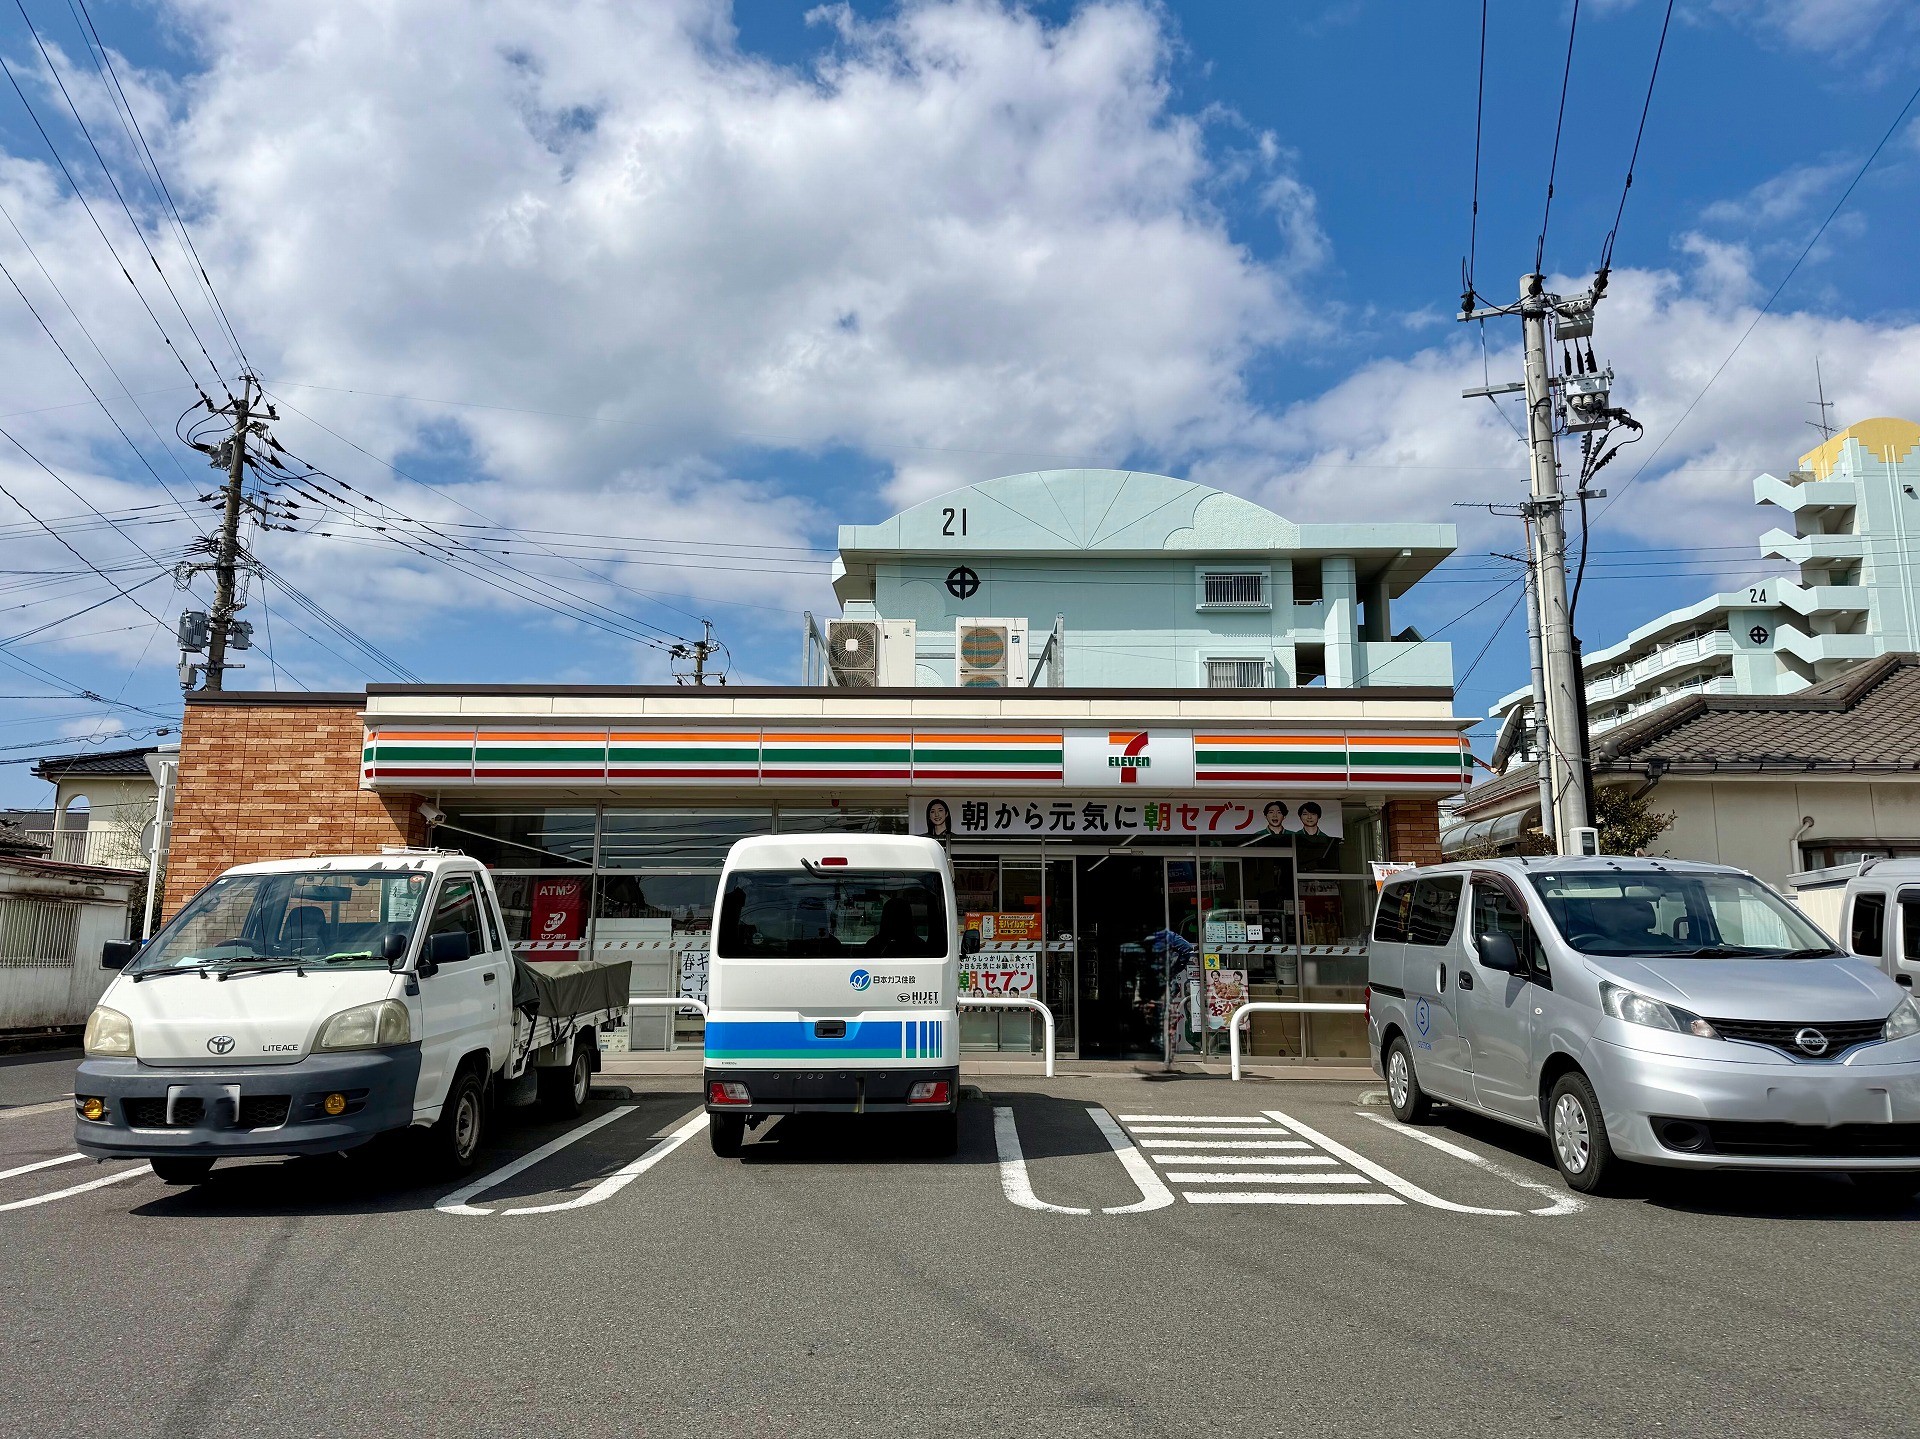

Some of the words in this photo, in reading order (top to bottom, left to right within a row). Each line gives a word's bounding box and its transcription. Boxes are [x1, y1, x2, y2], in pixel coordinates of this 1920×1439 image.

[942, 508, 967, 536] 21
[1749, 588, 1767, 603] 24
[961, 800, 1254, 832] 朝から元気に朝セブン
[872, 975, 916, 984] 日本ガス住設
[959, 969, 1034, 992] 朝セブン
[912, 991, 939, 1001] HIJET
[262, 1044, 299, 1052] LITEACE
